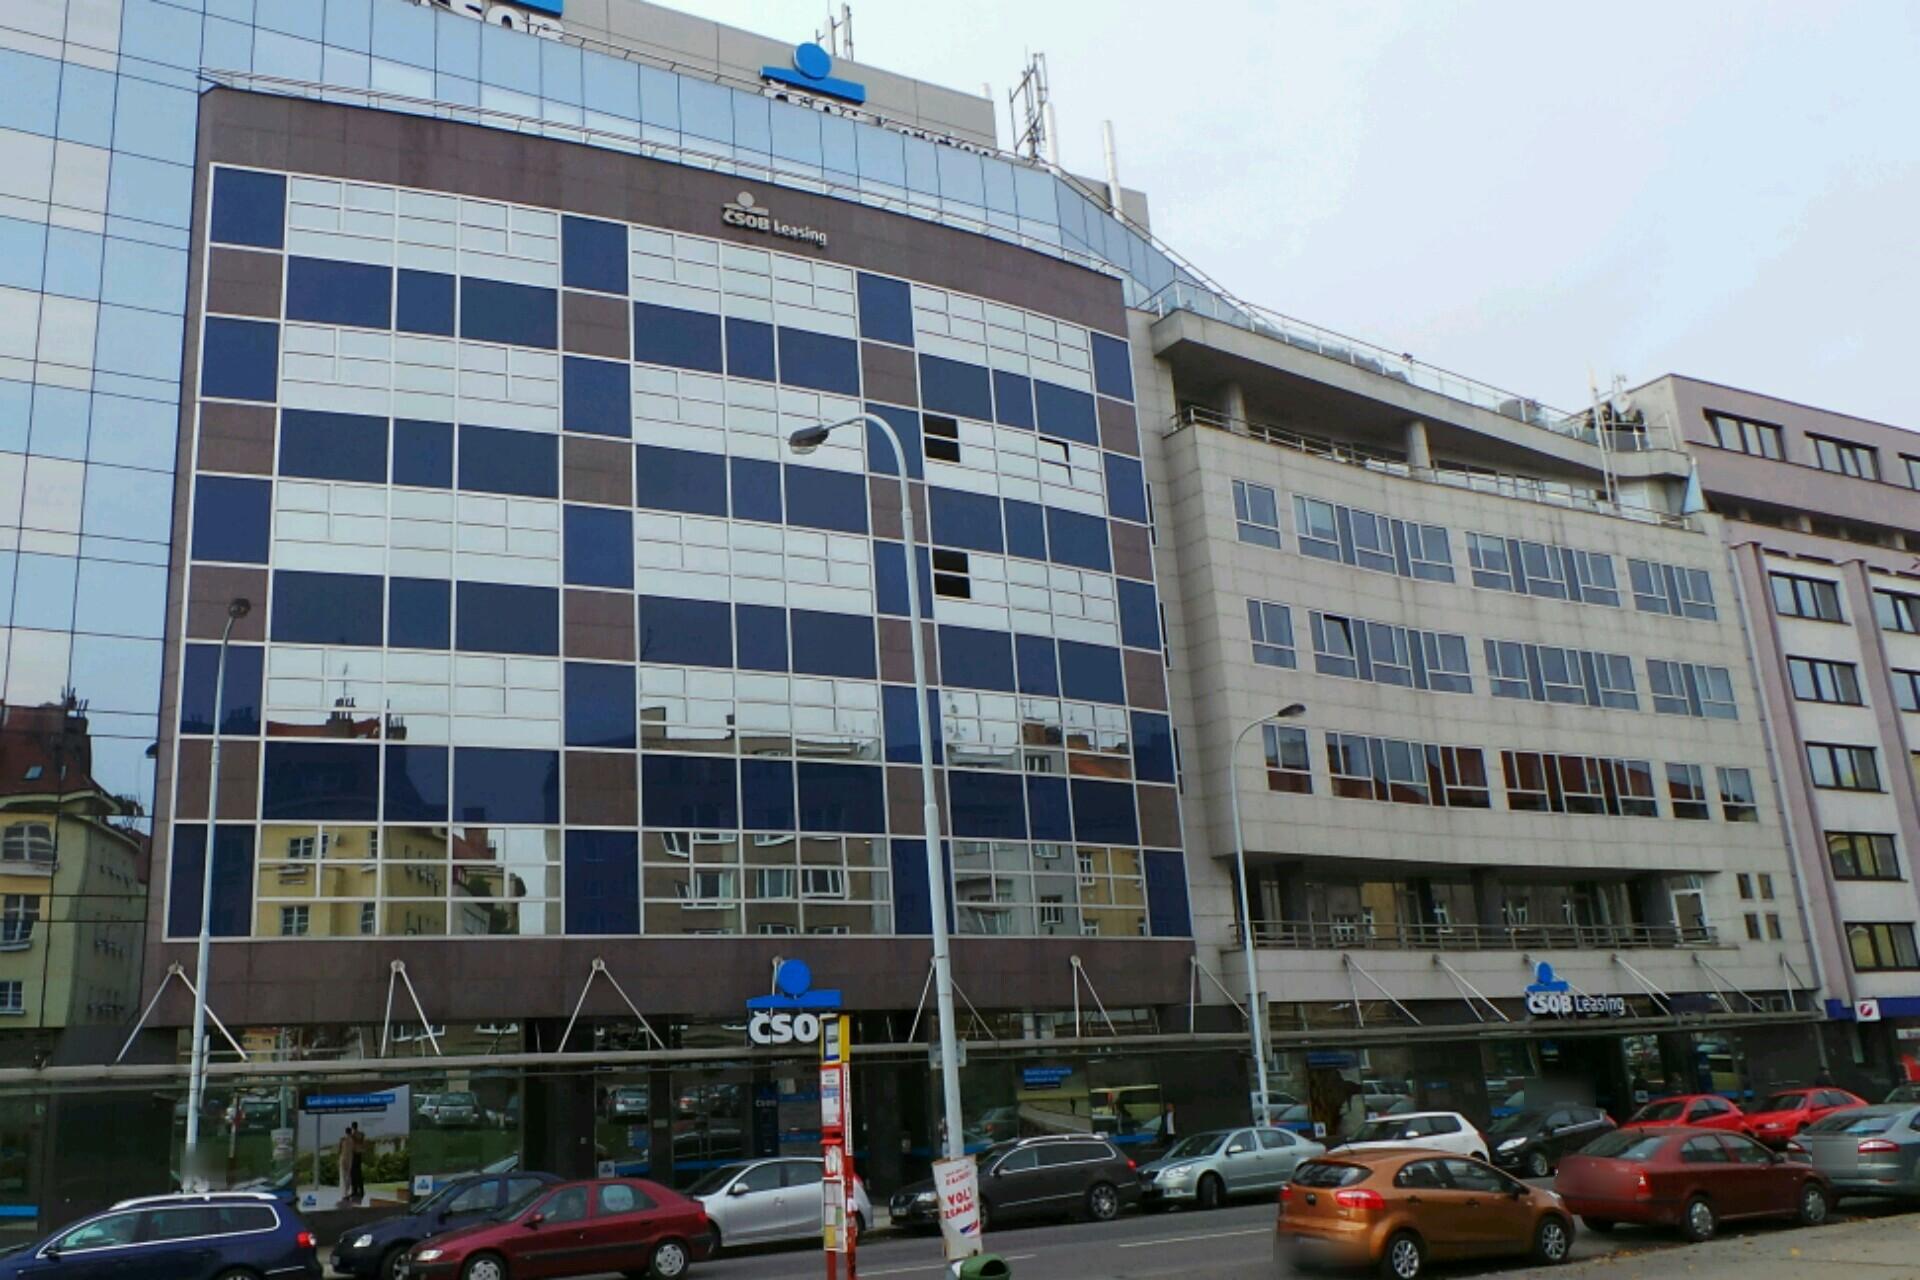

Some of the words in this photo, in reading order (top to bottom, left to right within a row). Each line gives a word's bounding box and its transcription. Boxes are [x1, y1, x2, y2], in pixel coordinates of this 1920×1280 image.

[723, 208, 769, 230] ČSOB
[773, 219, 827, 247] Leasing
[1528, 991, 1573, 1015] ČSOB
[1575, 994, 1625, 1016] Leasing
[749, 1011, 819, 1044] ČSO
